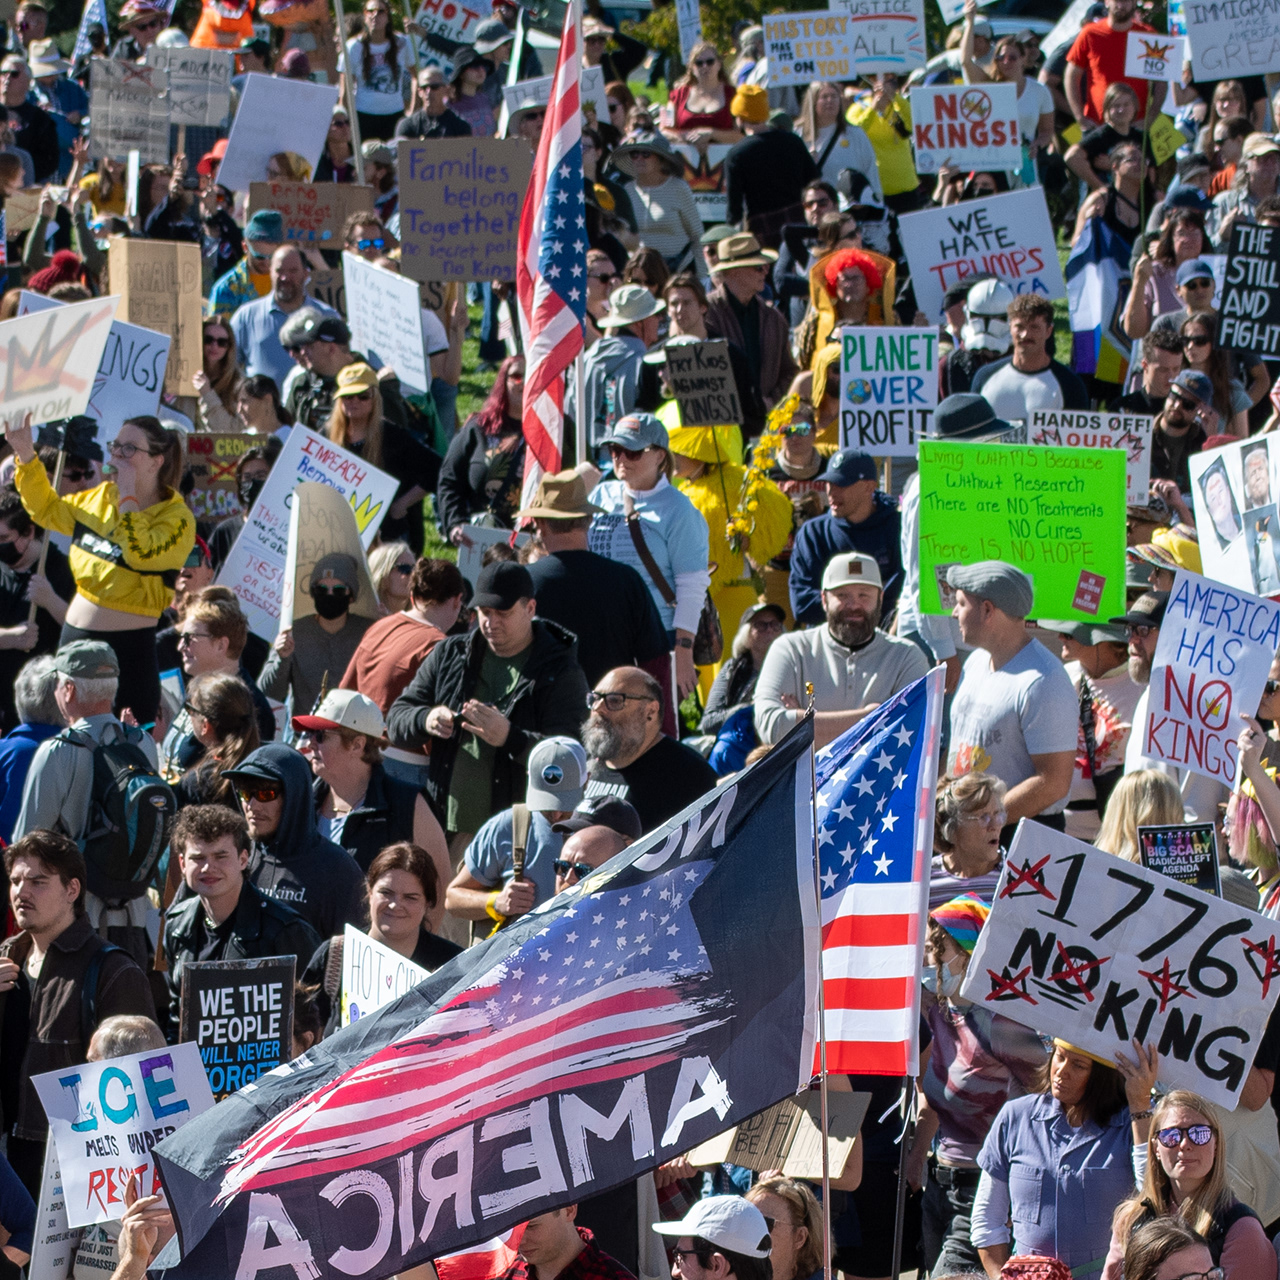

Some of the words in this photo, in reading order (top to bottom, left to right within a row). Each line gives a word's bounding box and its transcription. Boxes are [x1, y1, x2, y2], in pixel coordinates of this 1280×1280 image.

[765, 16, 849, 40] HISTORY
[1235, 16, 1270, 28] MAKE
[795, 40, 834, 58] EYES
[854, 35, 905, 55] ALL
[794, 61, 814, 73] ON
[816, 60, 850, 77] YOU
[915, 120, 1019, 150] KINGS!
[948, 208, 993, 233] WE
[939, 227, 1016, 260] HATE
[1236, 225, 1272, 254] THE
[1227, 256, 1279, 288] STILL
[1223, 289, 1269, 319] AND
[844, 334, 936, 372] PLANET
[841, 409, 935, 448] PROFIT
[1177, 630, 1238, 676] HAS
[1161, 671, 1234, 732] NO
[1146, 718, 1239, 783] KINGS
[1147, 846, 1167, 857] BIG
[1169, 842, 1210, 856] SCARY
[1148, 856, 1188, 866] RADICAL
[1190, 854, 1211, 863] LEFT
[1162, 864, 1200, 874] AGENDA
[1036, 851, 1254, 999] 1776
[1012, 927, 1102, 995] NO
[199, 987, 235, 1017] WE
[239, 982, 282, 1013] THE
[198, 1012, 281, 1046] PEOPLE
[1092, 980, 1252, 1093] KING
[200, 1046, 233, 1064] WILL
[237, 1040, 280, 1062] NEVER
